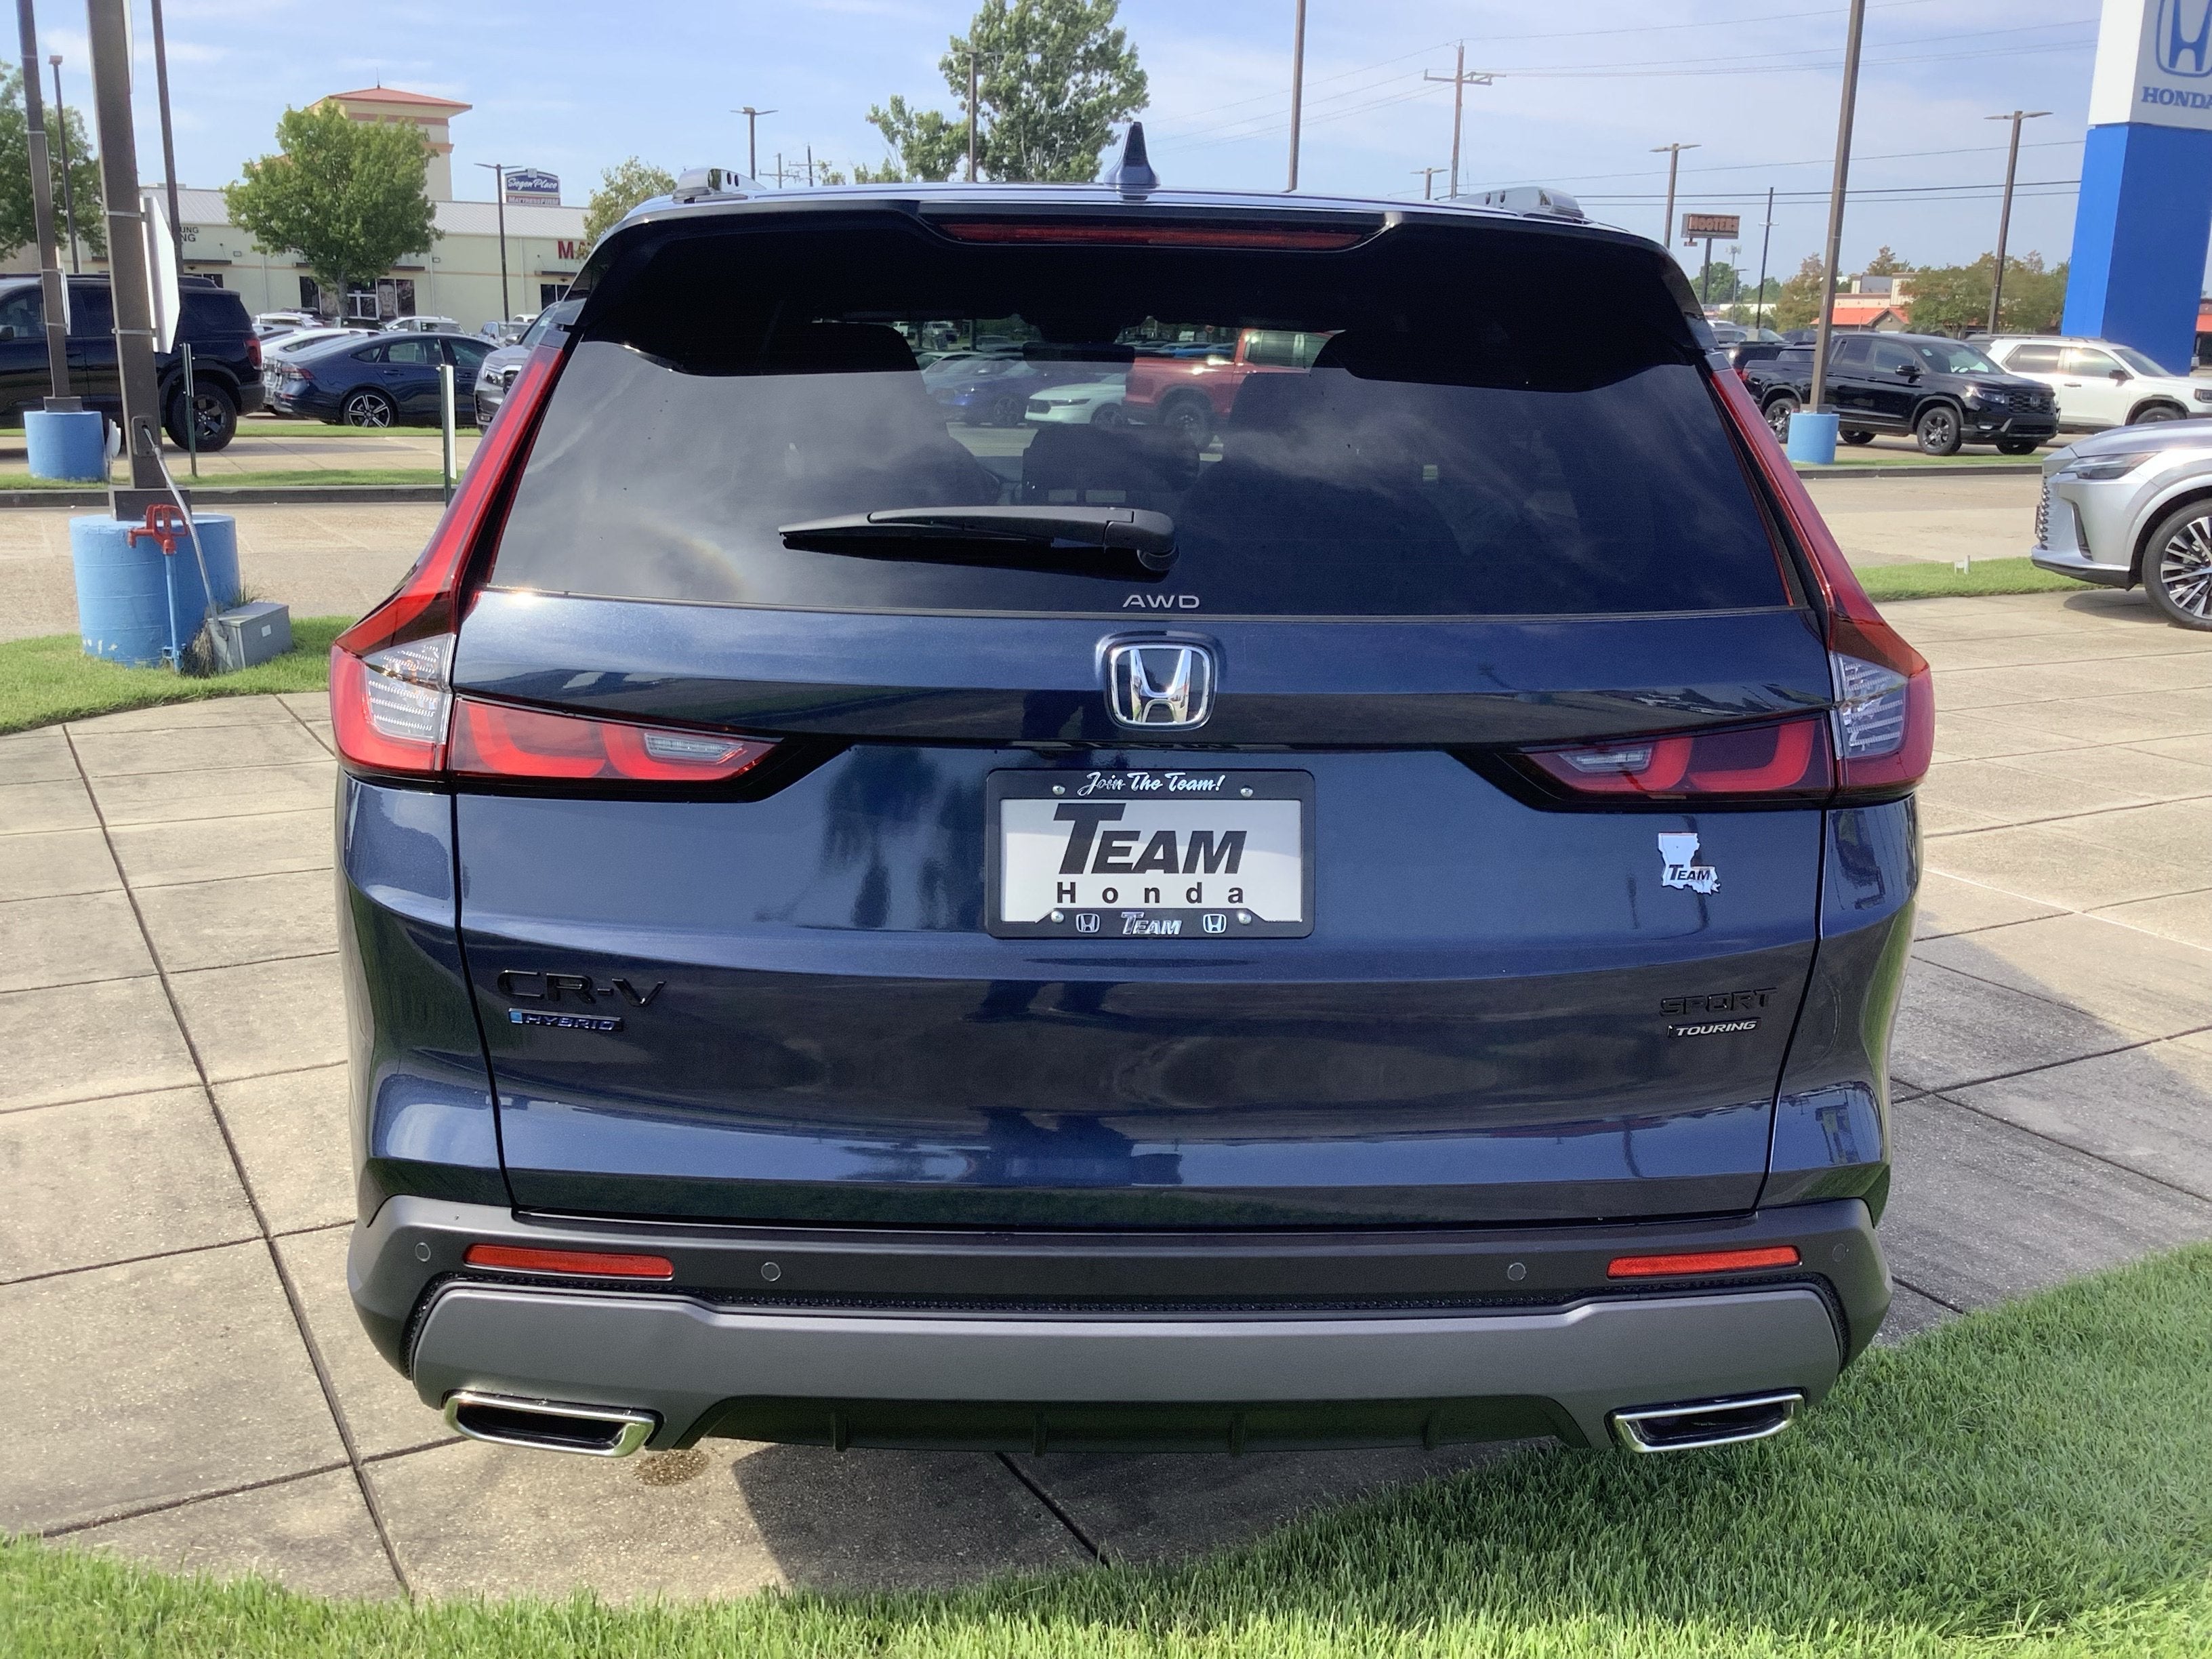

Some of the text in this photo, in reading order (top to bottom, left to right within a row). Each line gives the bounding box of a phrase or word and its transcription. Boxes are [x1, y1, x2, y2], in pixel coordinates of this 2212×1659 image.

[533, 178, 558, 189] Place
[1689, 216, 1738, 232] HOOTERS
[1122, 594, 1201, 609] AWD
[1077, 771, 1226, 796] Join The Team!
[1053, 802, 1248, 874] TEAM
[1668, 864, 1711, 881] TEAM
[1057, 882, 1244, 904] Honda
[1120, 911, 1183, 935] TEAM
[497, 968, 667, 1007] CR-V
[1660, 988, 1778, 1017] SPORT
[525, 1015, 617, 1031] HYBRID
[1676, 1021, 1759, 1036] TOURING
